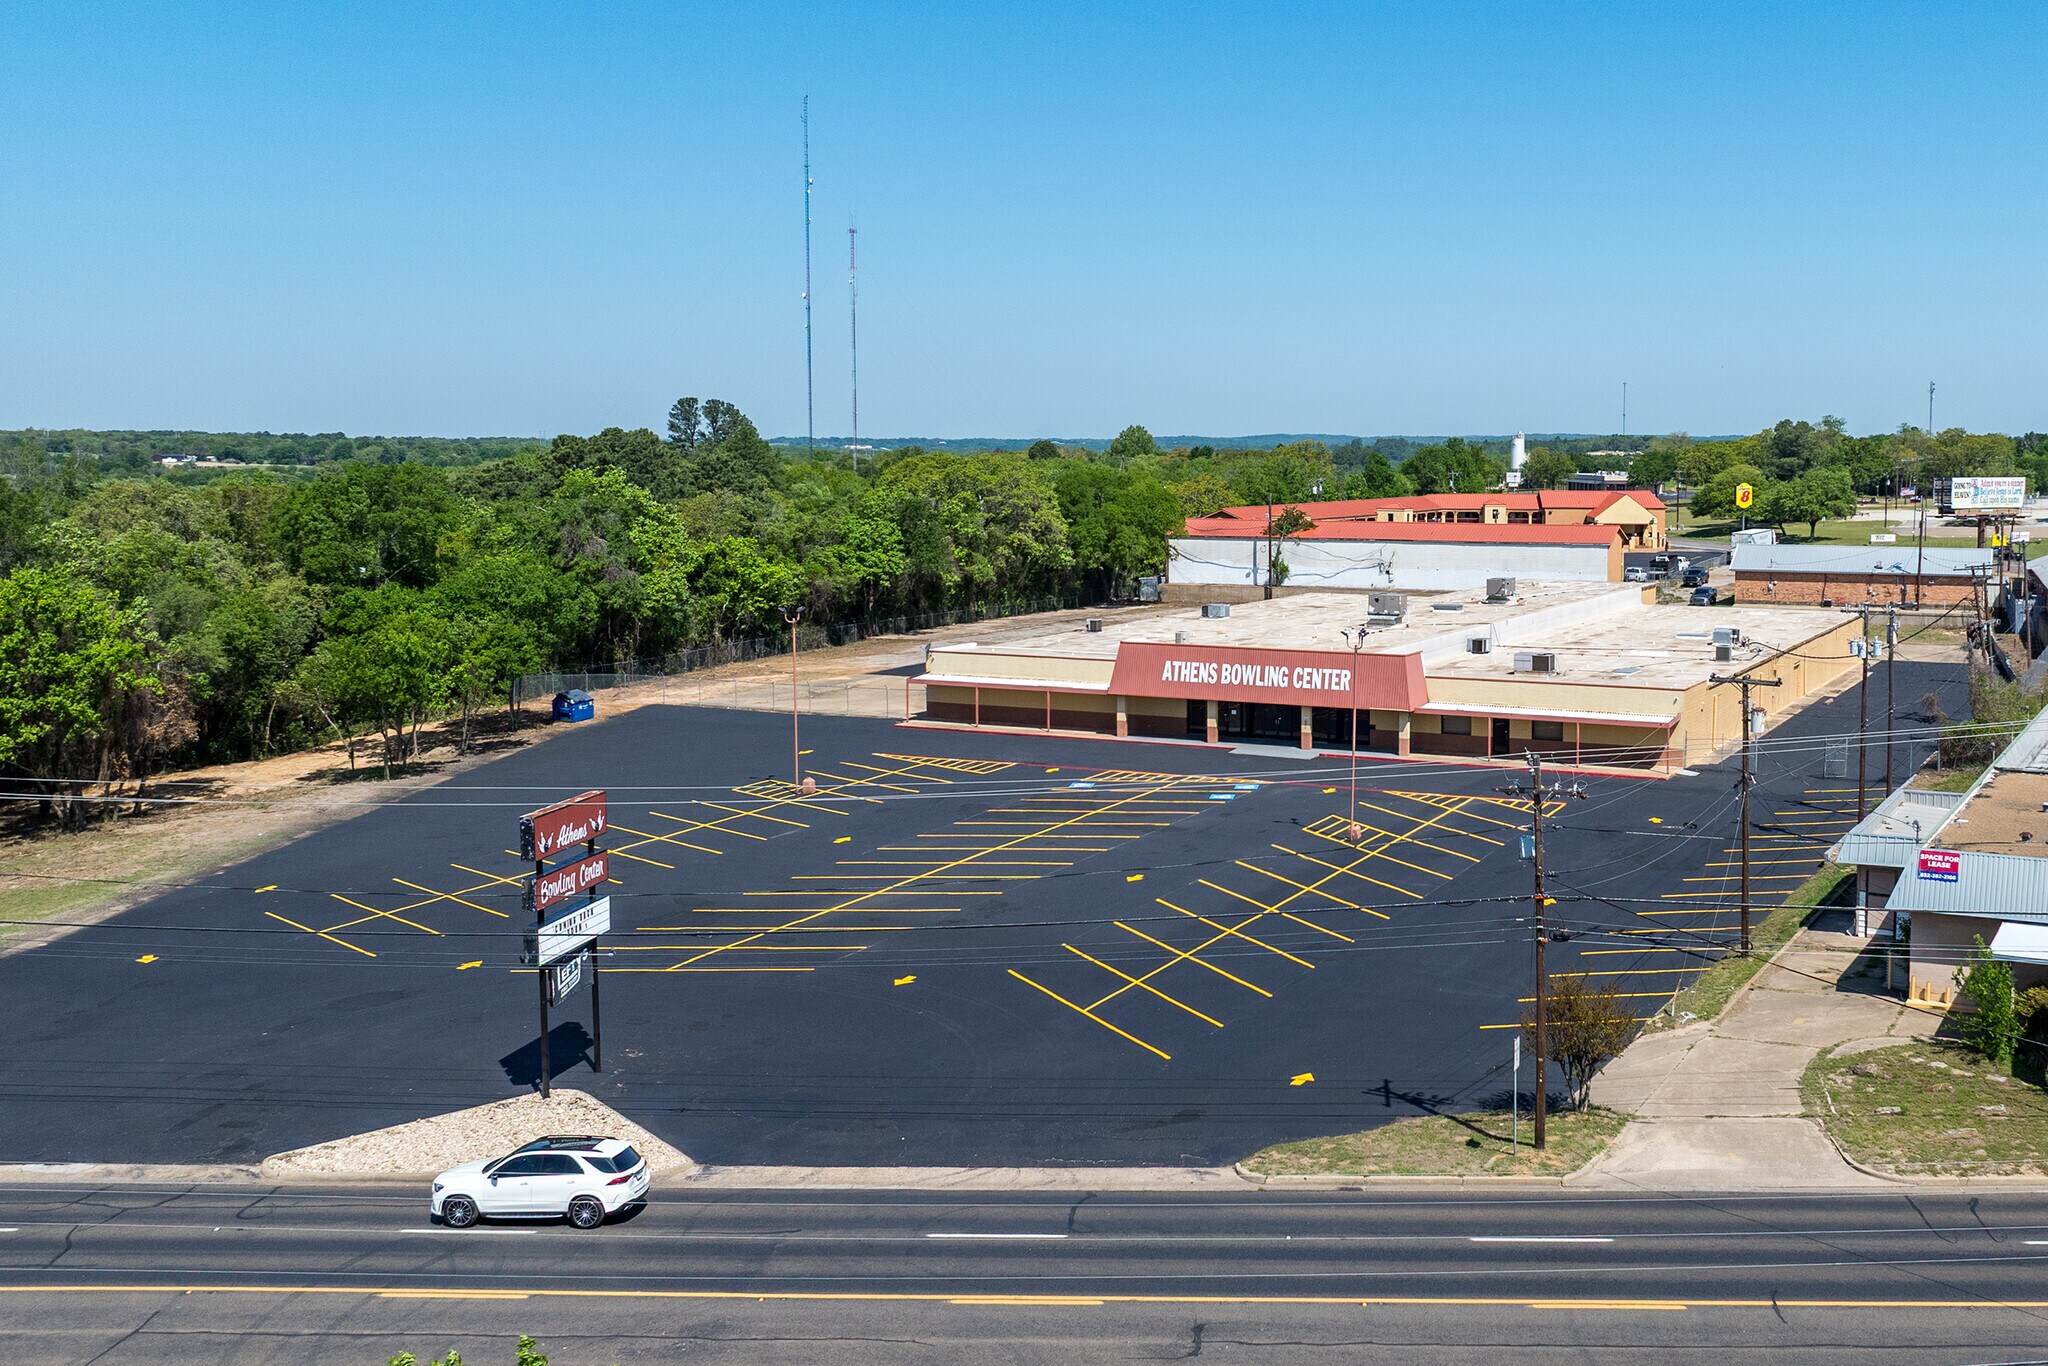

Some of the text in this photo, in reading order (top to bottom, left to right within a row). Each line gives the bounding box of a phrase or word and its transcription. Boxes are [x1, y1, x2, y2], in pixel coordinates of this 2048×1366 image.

[1740, 491, 1750, 502] 8
[1162, 660, 1351, 691] ATHENS BOWLING CENTER
[557, 822, 587, 848] Athens
[1920, 853, 1960, 863] SPACE FOR
[541, 860, 604, 904] Bowling Center
